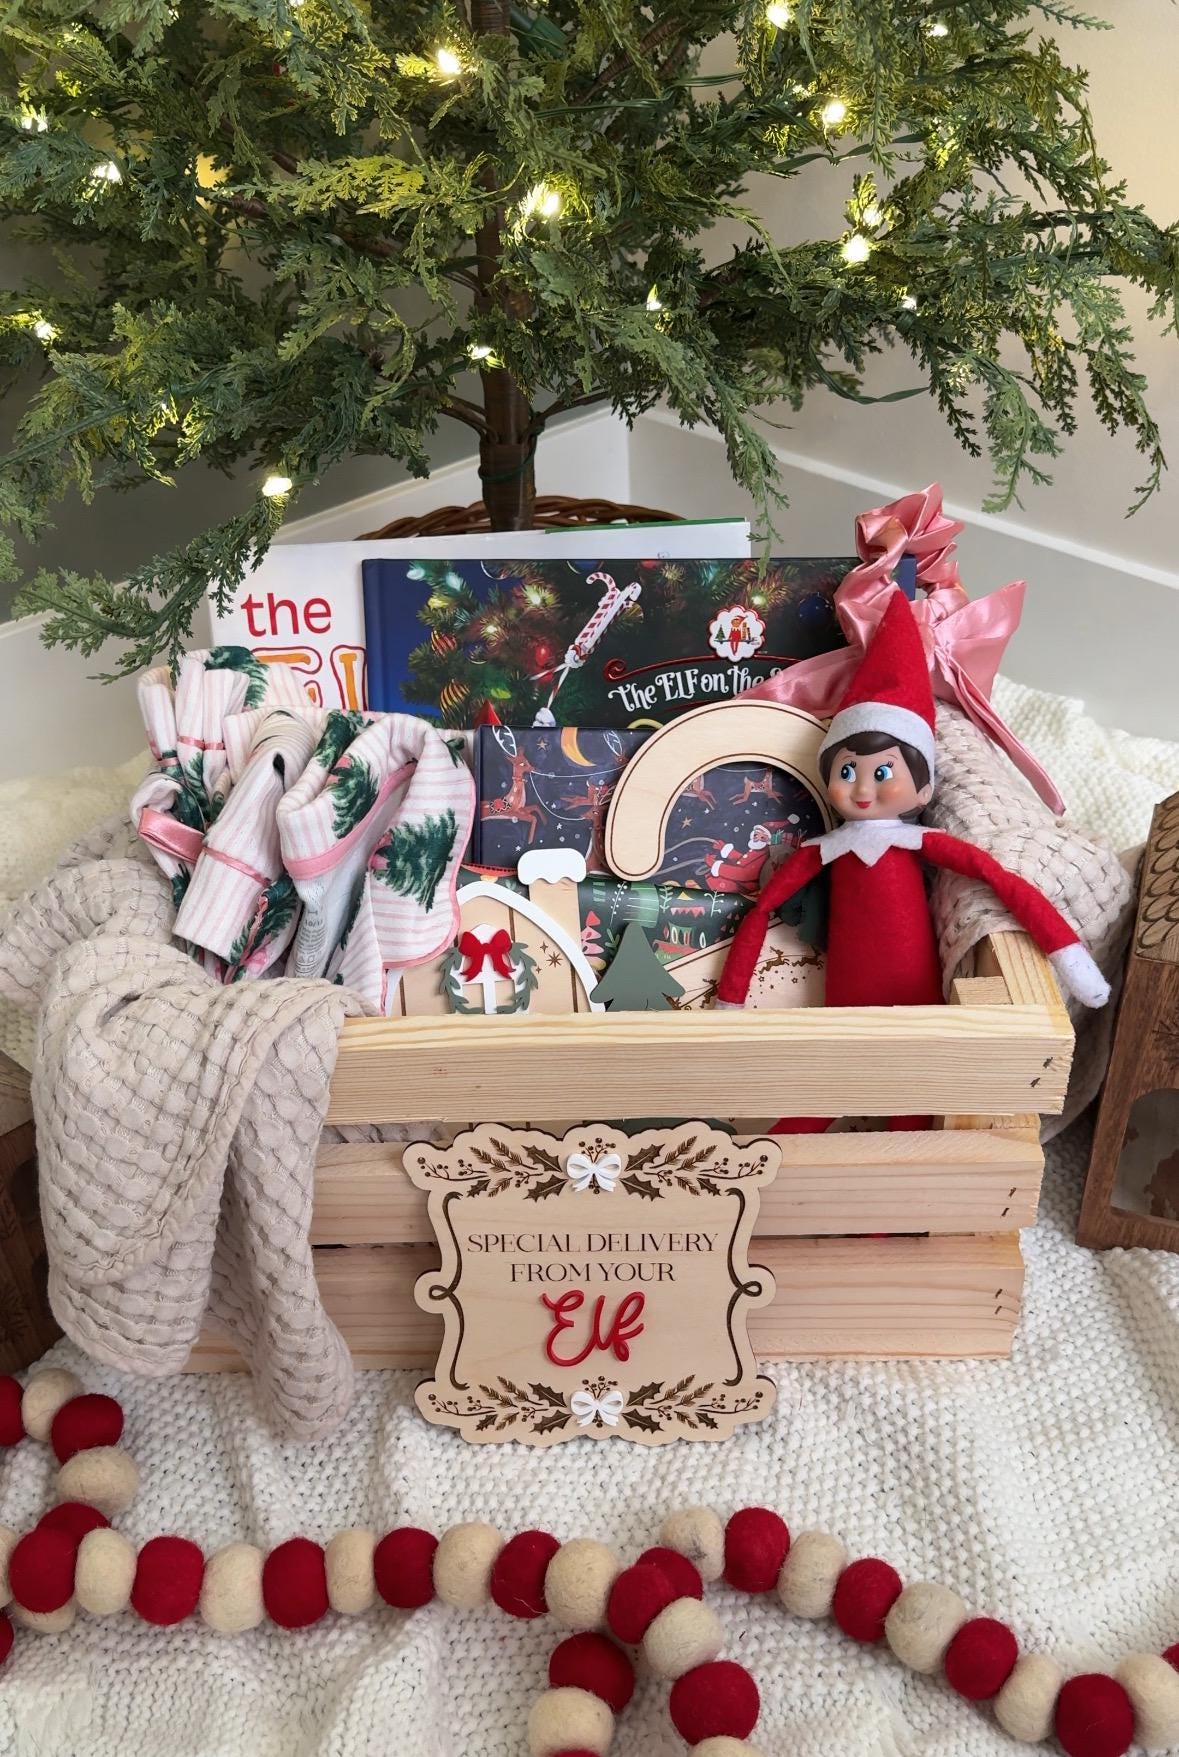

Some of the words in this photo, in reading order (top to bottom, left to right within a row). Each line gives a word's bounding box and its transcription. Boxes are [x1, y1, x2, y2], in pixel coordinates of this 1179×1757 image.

[240, 592, 332, 637] the
[654, 668, 699, 702] ELF
[700, 673, 730, 694] on
[467, 1233, 581, 1253] SPECIAL
[586, 1233, 719, 1253] DELIVERY
[510, 1262, 591, 1283] FROM
[598, 1262, 676, 1282] YOUR
[540, 1289, 645, 1367] Elf
